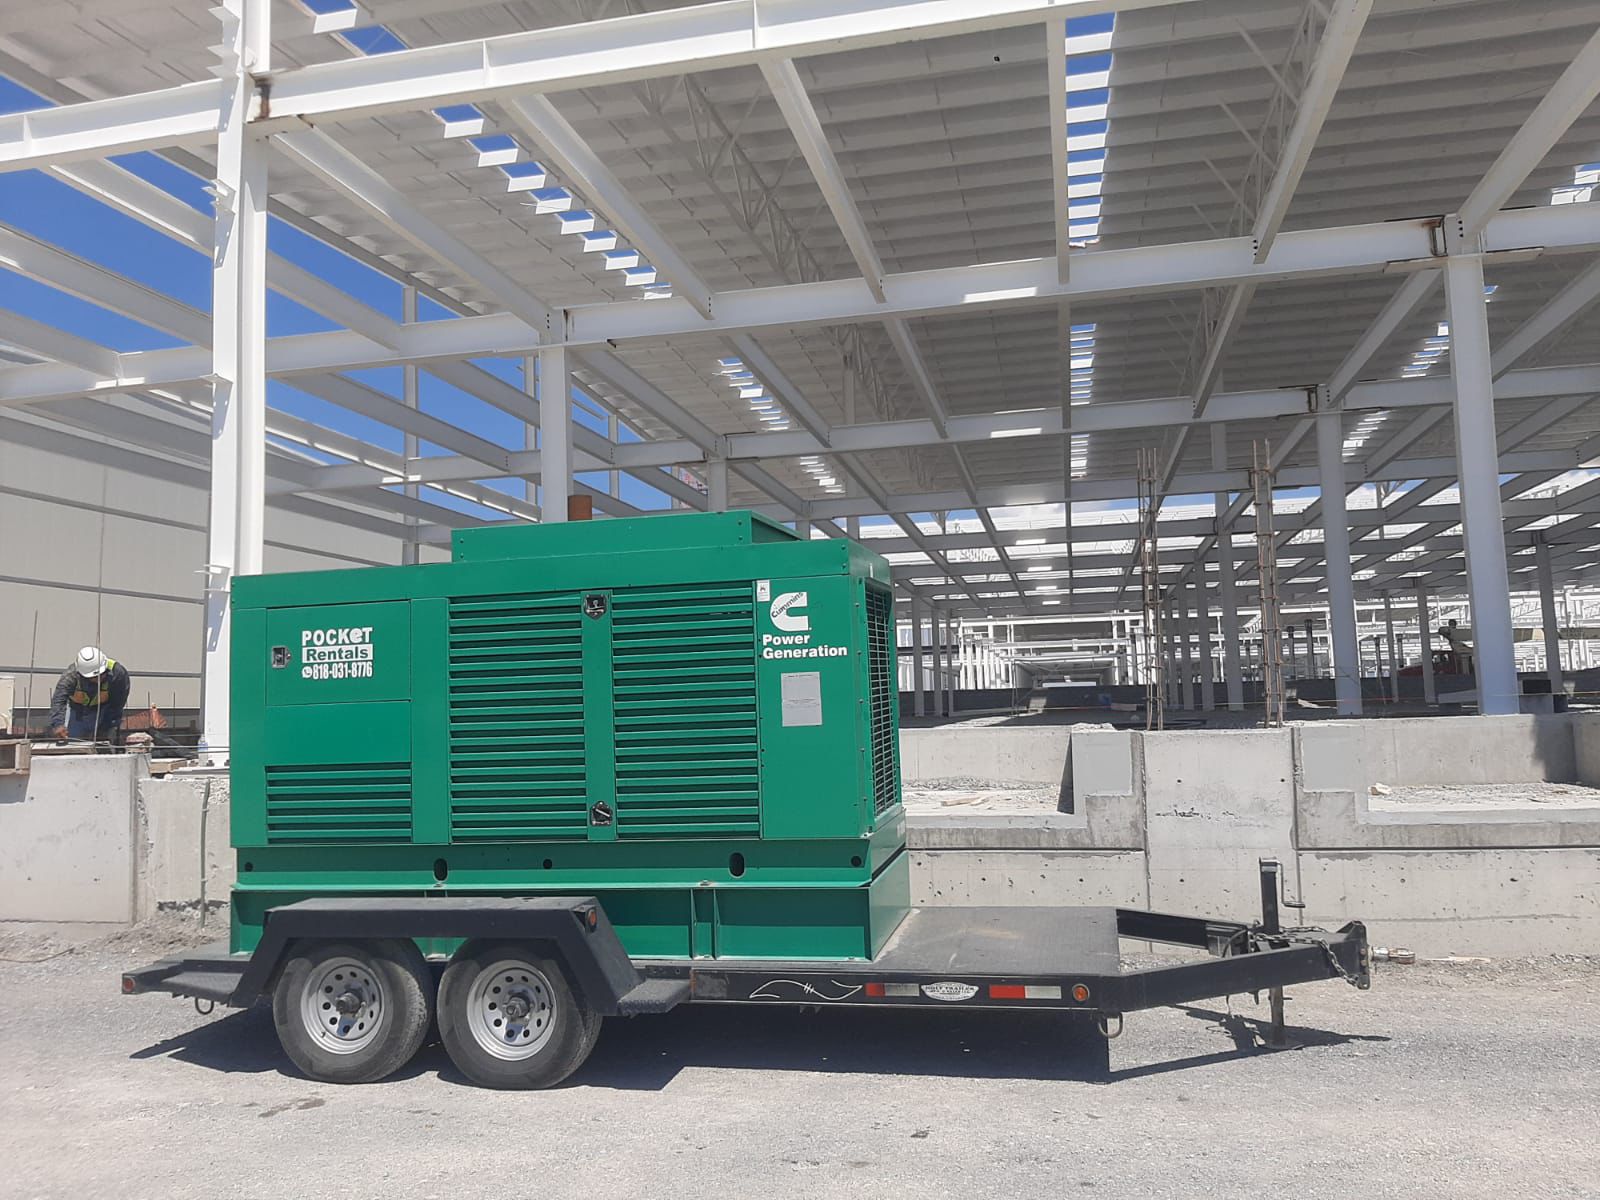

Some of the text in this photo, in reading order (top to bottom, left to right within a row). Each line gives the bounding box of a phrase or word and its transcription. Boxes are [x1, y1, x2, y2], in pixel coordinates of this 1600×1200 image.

[771, 592, 804, 618] Cummins
[762, 634, 810, 646] Power
[306, 647, 369, 662] Rentals
[762, 645, 848, 659] Generation
[312, 661, 373, 680] 818-031-8776
